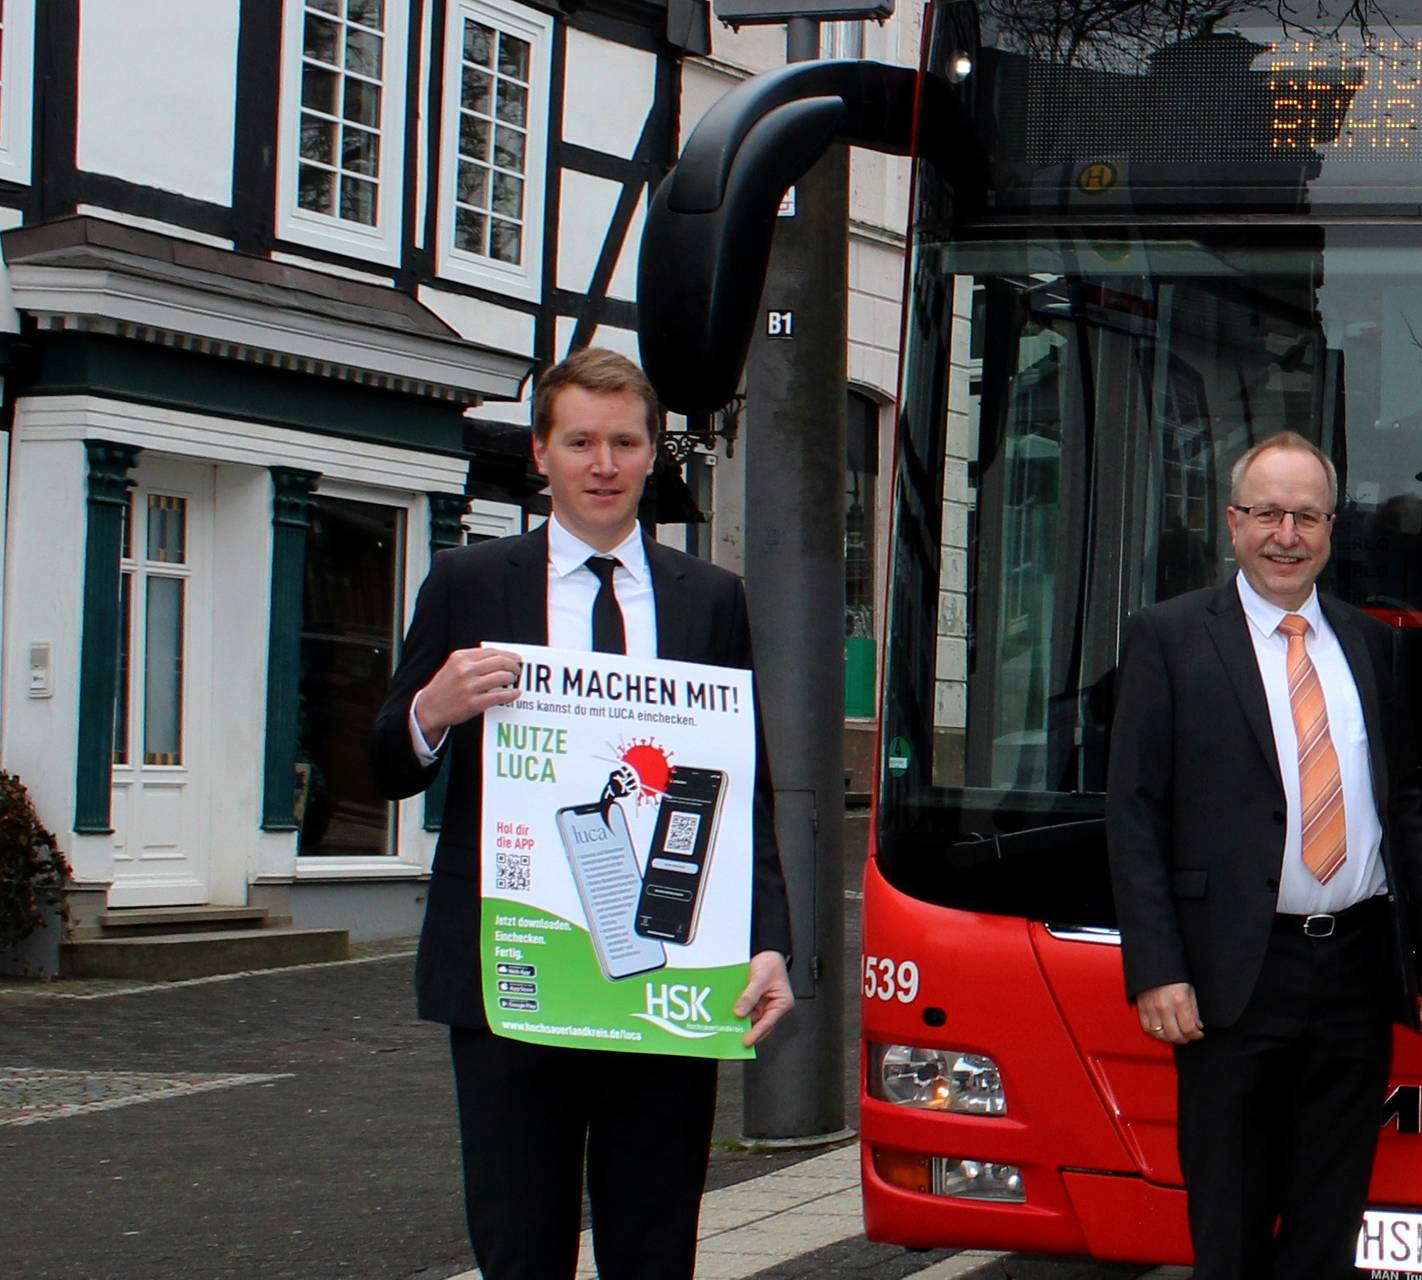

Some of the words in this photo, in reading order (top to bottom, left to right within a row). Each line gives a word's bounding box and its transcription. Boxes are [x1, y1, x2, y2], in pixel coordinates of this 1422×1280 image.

[768, 312, 792, 334] B1
[562, 666, 677, 707] MACHEN
[686, 680, 739, 713] MIT!
[516, 700, 535, 711] uns
[536, 700, 572, 715] kannst
[574, 705, 588, 716] du
[589, 706, 607, 718] mit
[608, 707, 635, 720] LUCA
[637, 711, 698, 727] einchecken.
[496, 722, 568, 755] NUTZE
[496, 752, 558, 784] LUCA
[496, 822, 513, 835] Hol
[516, 824, 530, 836] dir
[571, 824, 608, 845] luca
[496, 837, 512, 849] die
[514, 838, 535, 850] APP
[495, 914, 516, 927] Jetzt
[518, 916, 572, 932] downloaden.
[495, 930, 547, 945] Einchecken.
[495, 946, 524, 960] Fertig.
[861, 955, 920, 1004] 539
[645, 982, 712, 1023] HSK
[1371, 1270, 1400, 1280] MAN
